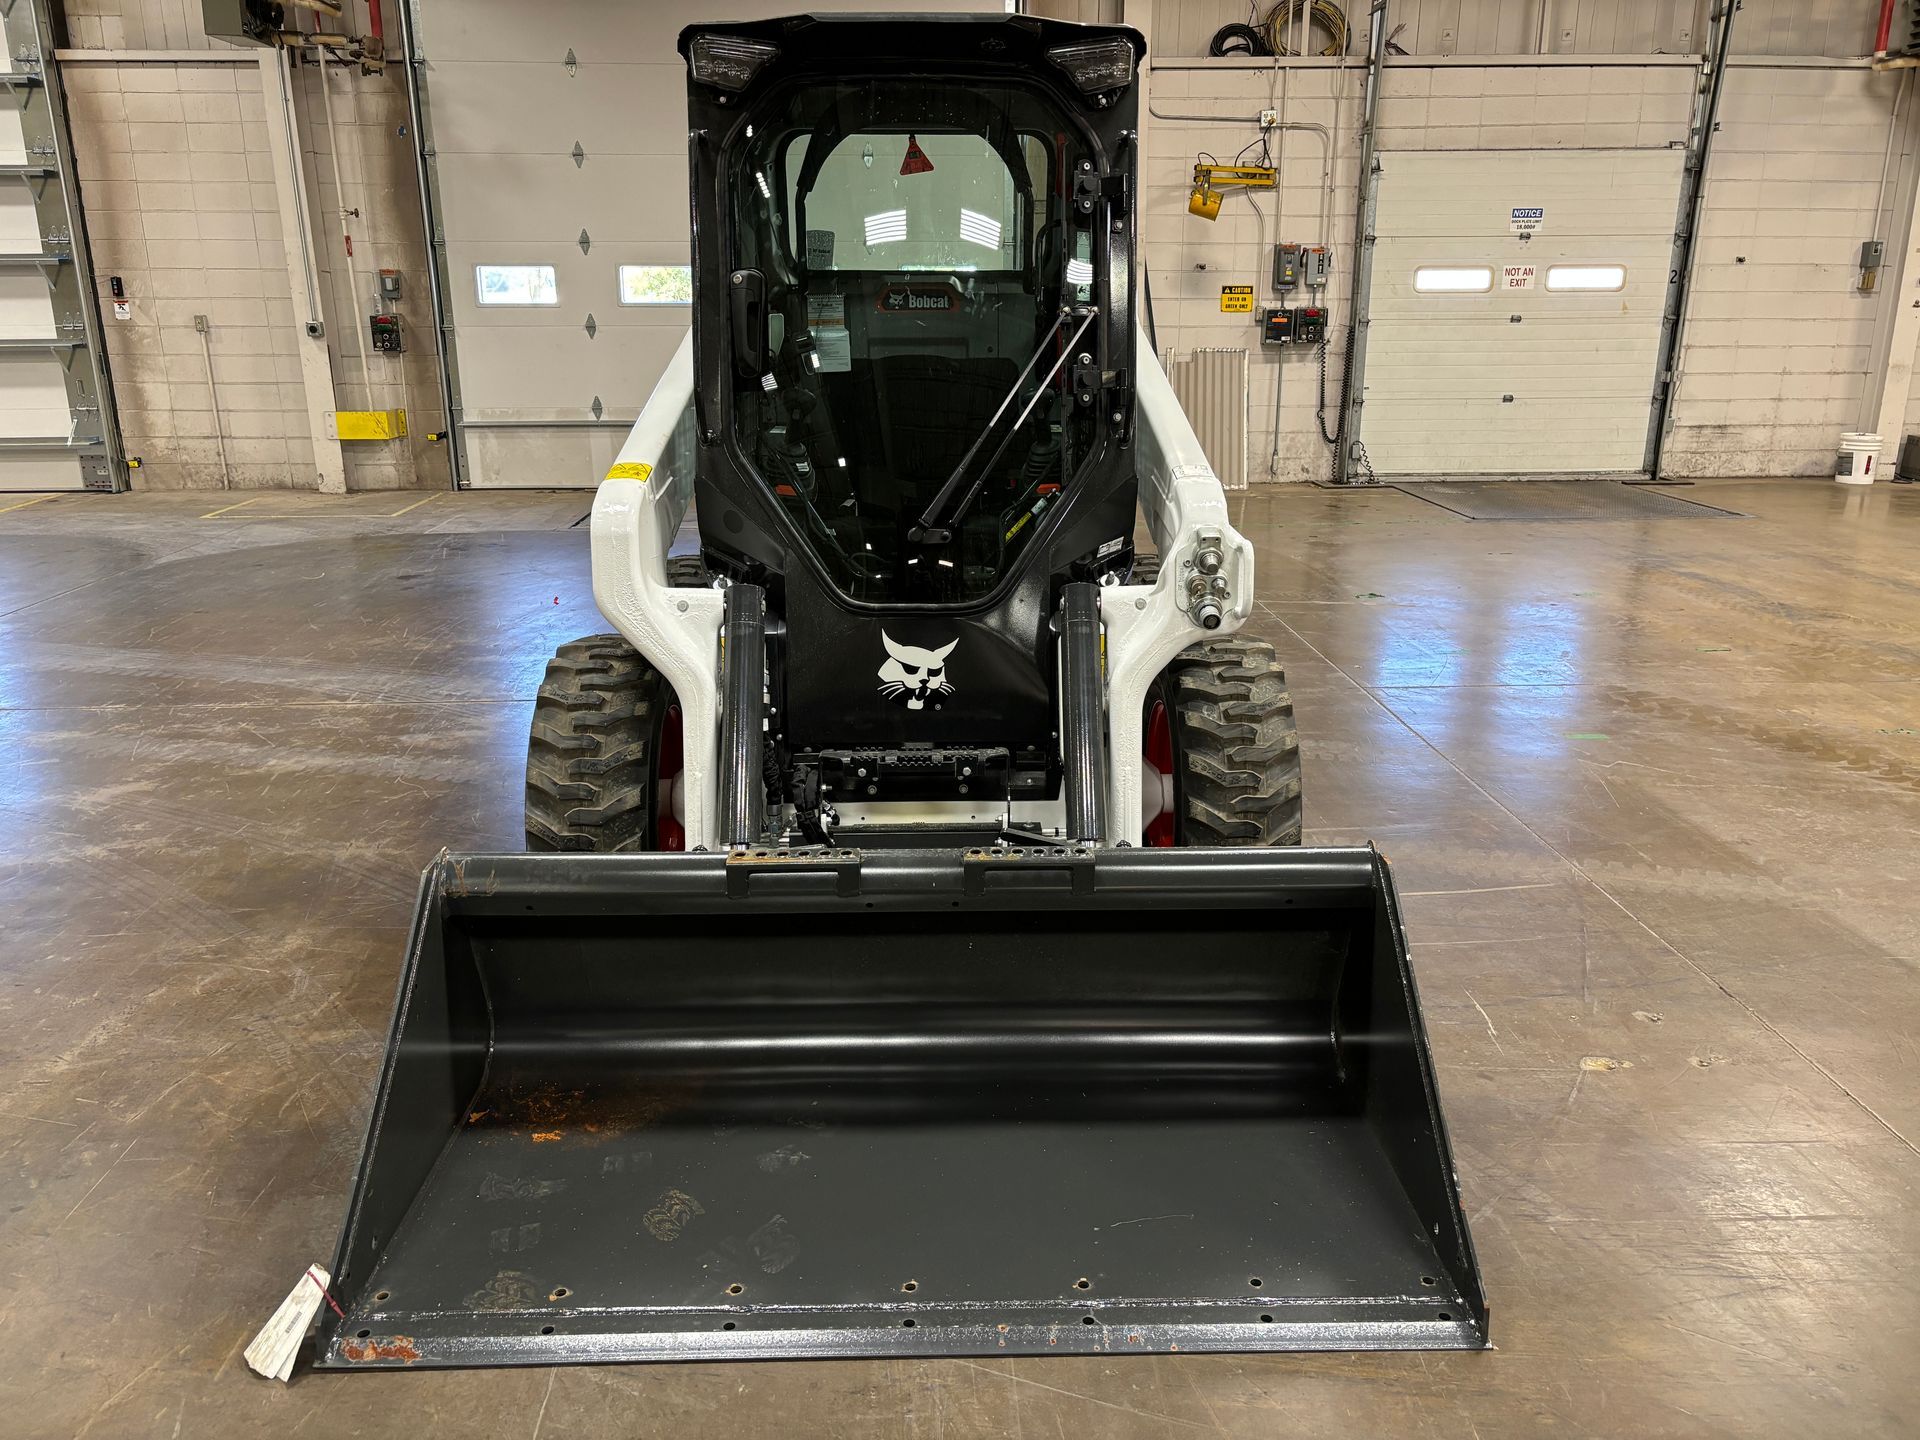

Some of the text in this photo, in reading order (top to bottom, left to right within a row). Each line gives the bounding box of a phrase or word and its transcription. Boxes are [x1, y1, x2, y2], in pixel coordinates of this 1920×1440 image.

[1513, 209, 1542, 217] NOTICE
[1504, 267, 1534, 277] NOT AN
[1670, 269, 1678, 284] 2
[1509, 278, 1527, 287] EXIT
[908, 295, 949, 309] Bobcat
